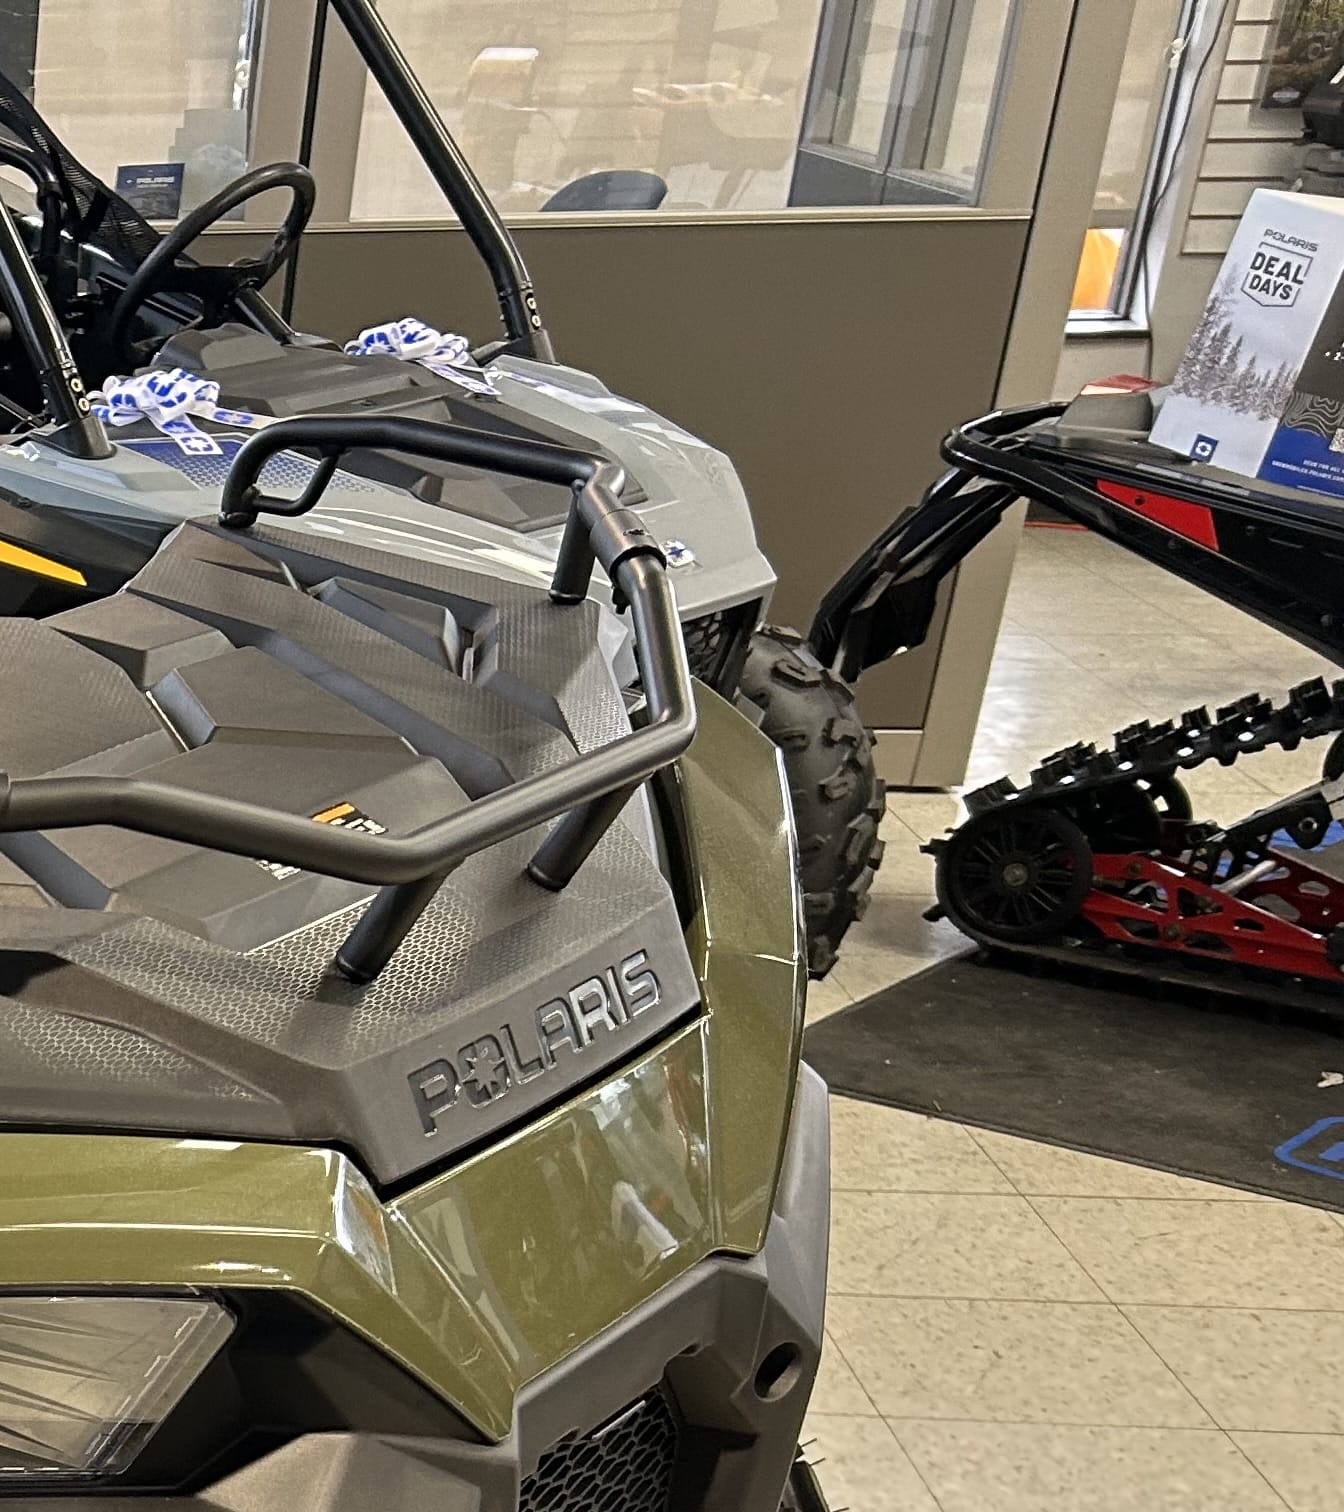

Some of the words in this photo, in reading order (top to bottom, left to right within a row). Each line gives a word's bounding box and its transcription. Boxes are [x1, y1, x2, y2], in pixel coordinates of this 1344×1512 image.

[1263, 228, 1320, 252] POLARIS
[1250, 251, 1305, 285] DEAL
[1248, 273, 1293, 300] DAYS
[407, 948, 662, 1138] POLARIS
